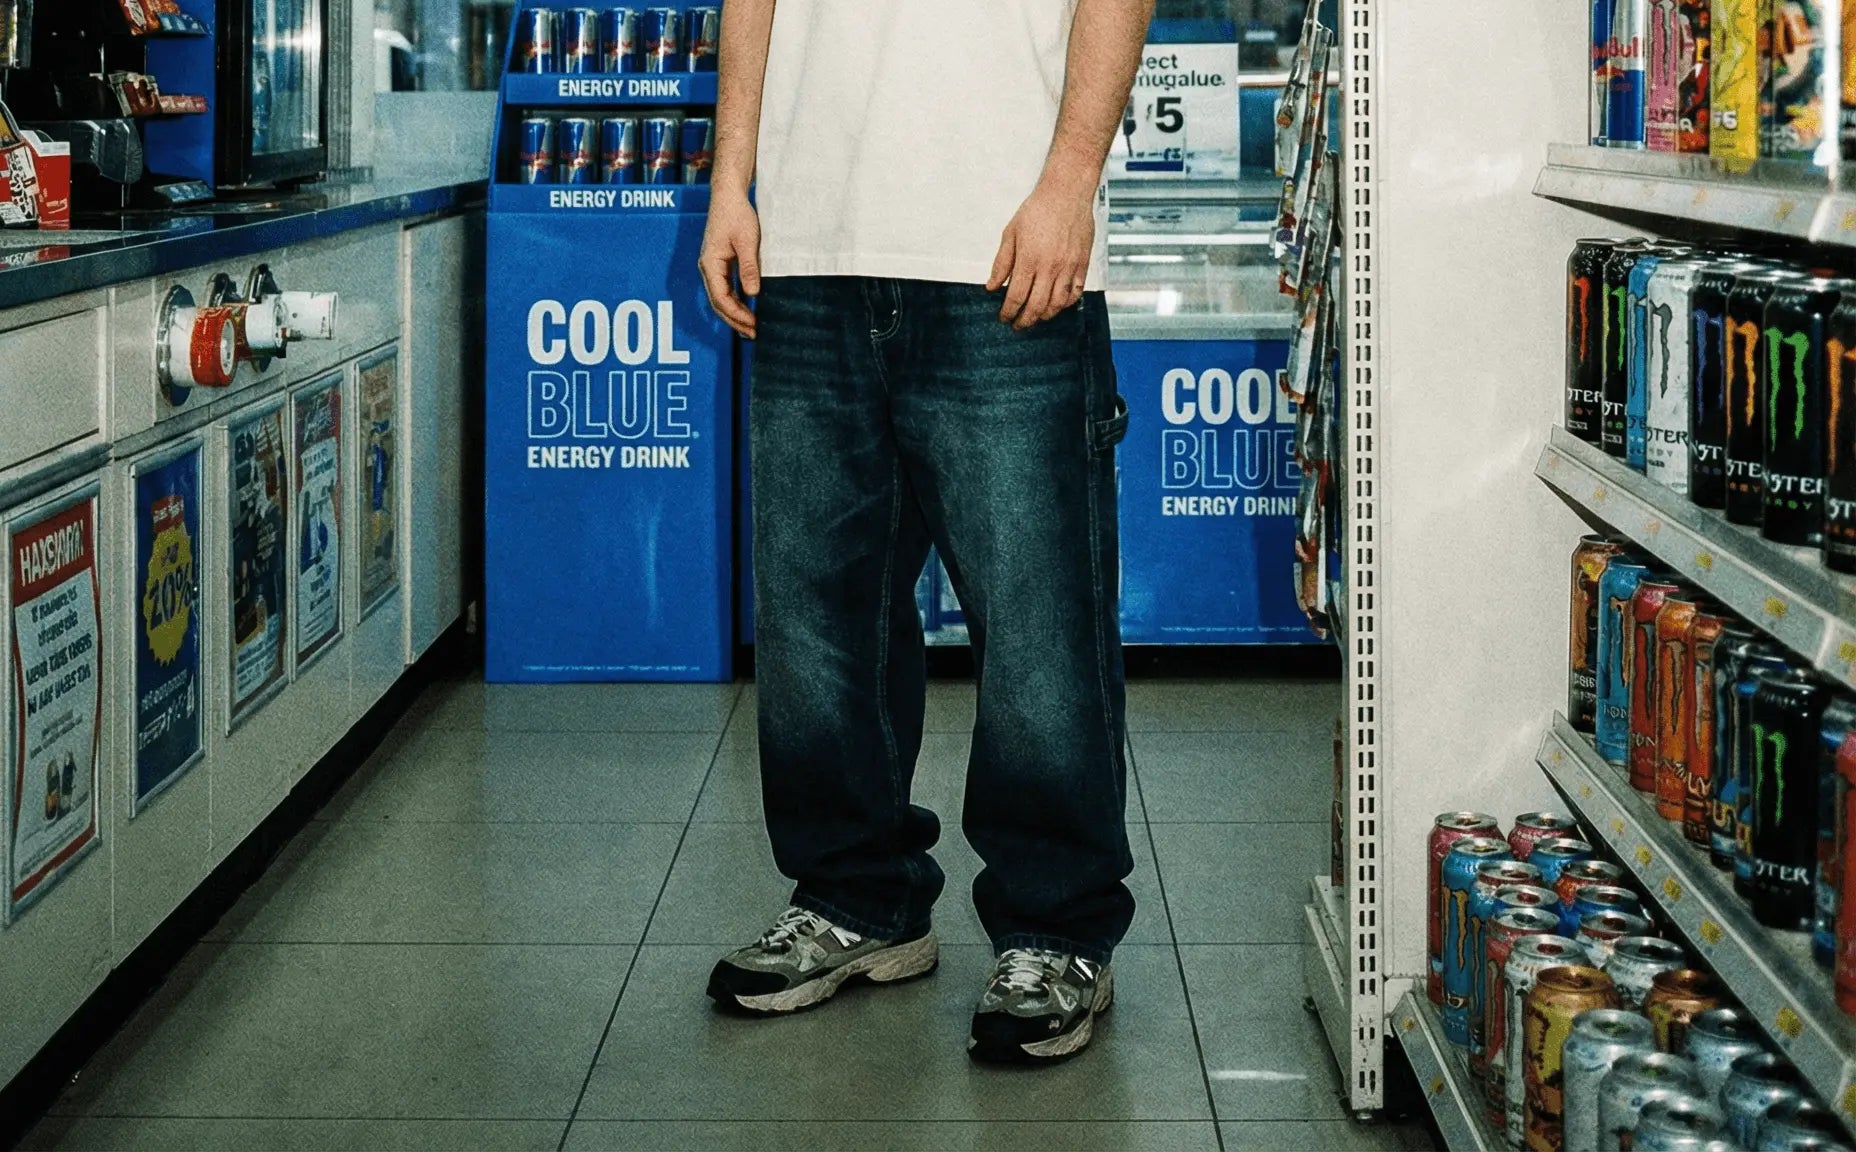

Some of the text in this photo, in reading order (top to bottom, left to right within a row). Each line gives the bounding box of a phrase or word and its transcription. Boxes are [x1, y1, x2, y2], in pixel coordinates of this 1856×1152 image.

[1140, 54, 1178, 69] ect
[558, 79, 681, 97] ENERGY DRINK
[1155, 97, 1184, 133] 5
[550, 190, 676, 208] ENERGY DRINK
[526, 299, 690, 366] COOL
[527, 370, 690, 439] BLUE
[527, 446, 690, 468] ENERGY DRINK
[1161, 496, 1239, 516] ENERGY
